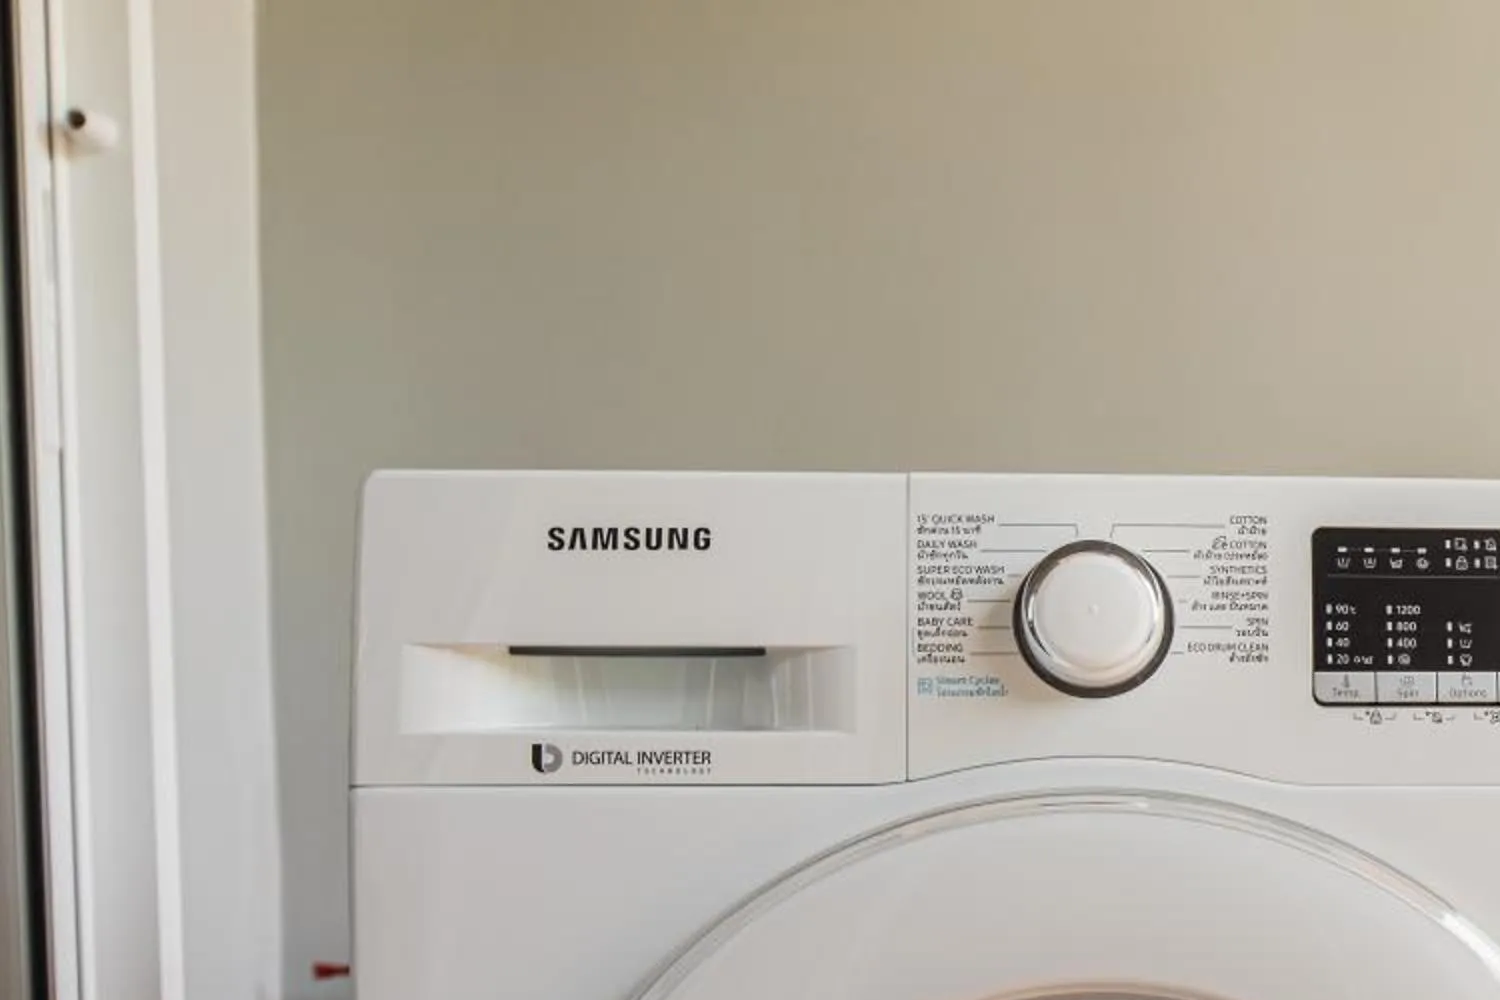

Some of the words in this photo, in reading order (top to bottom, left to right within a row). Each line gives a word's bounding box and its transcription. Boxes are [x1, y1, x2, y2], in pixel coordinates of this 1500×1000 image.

[931, 514, 963, 523] QUICK
[966, 514, 995, 523] WASH
[1230, 515, 1267, 524] COTTON
[547, 526, 711, 551] SAMSUNG
[917, 540, 945, 548] DAILY
[947, 540, 977, 548] WASH
[1230, 540, 1267, 549] COTTON
[917, 565, 950, 574] SUPER
[952, 565, 973, 574] ECO
[974, 565, 1005, 574] WASH
[1209, 565, 1267, 574] SYNTHETICS
[917, 591, 944, 600] WOOL
[1396, 605, 1421, 615] 1200
[917, 617, 944, 626] BABY
[946, 617, 974, 626] CARE
[1247, 617, 1269, 626] SPIN
[1335, 621, 1349, 631] 60
[1396, 621, 1417, 631] 800
[1187, 641, 1206, 652] ECO
[1238, 642, 1269, 651] CLEAN
[1335, 637, 1350, 647] 40
[1396, 637, 1417, 648] 400
[917, 643, 963, 652] BEDDING
[1336, 654, 1350, 664] 20
[571, 751, 632, 765] DIGITAL
[637, 751, 711, 765] INVERTER
